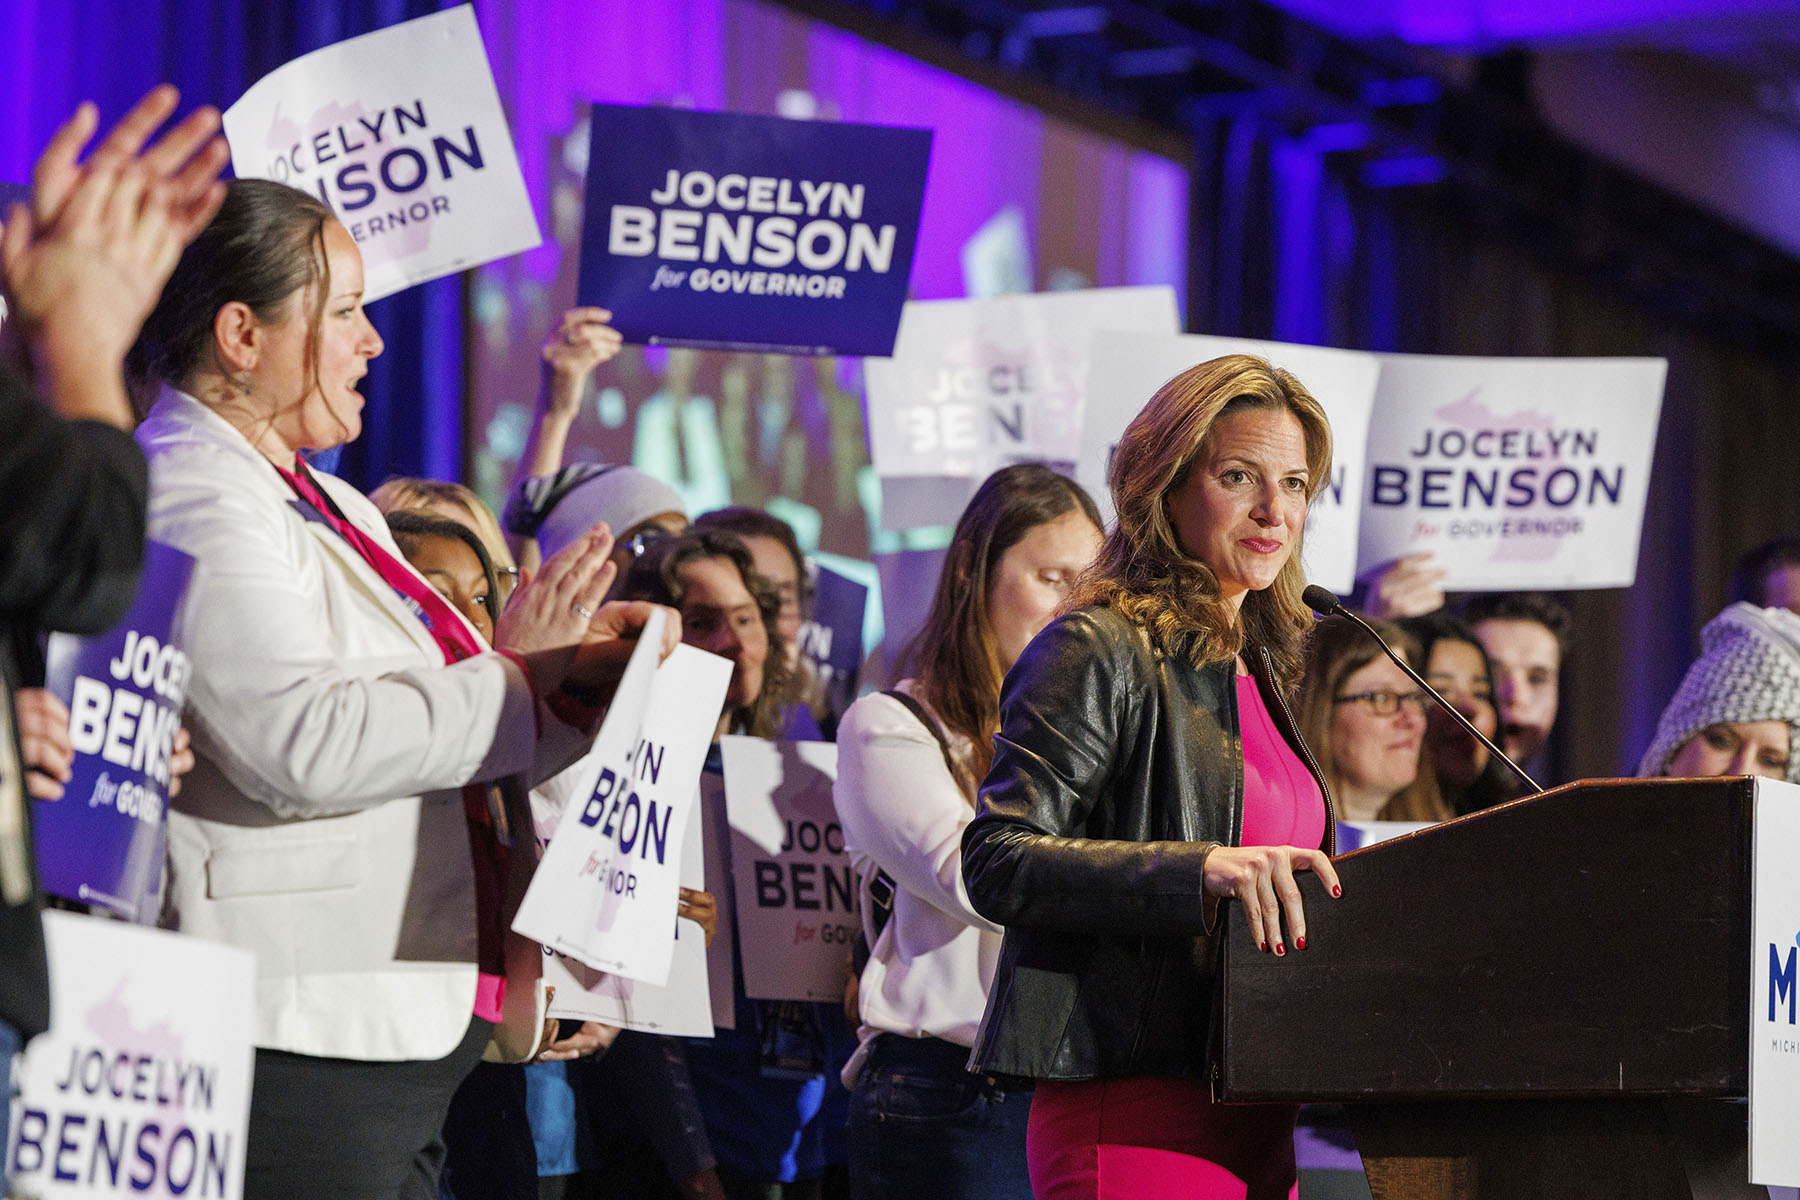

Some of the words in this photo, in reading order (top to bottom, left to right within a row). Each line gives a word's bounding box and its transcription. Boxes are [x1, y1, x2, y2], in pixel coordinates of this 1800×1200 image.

[650, 168, 866, 220] JOCELYN
[607, 203, 898, 274] BENSON
[650, 264, 687, 291] for
[688, 267, 847, 300] GOVERNOR
[1410, 427, 1599, 461] JOCELYN
[1370, 464, 1625, 510] BENSON
[1447, 514, 1585, 539] GOVERNOR
[754, 860, 862, 915] BEN
[57, 1046, 218, 1109] JOCELYN
[13, 1106, 234, 1200] BENSON
